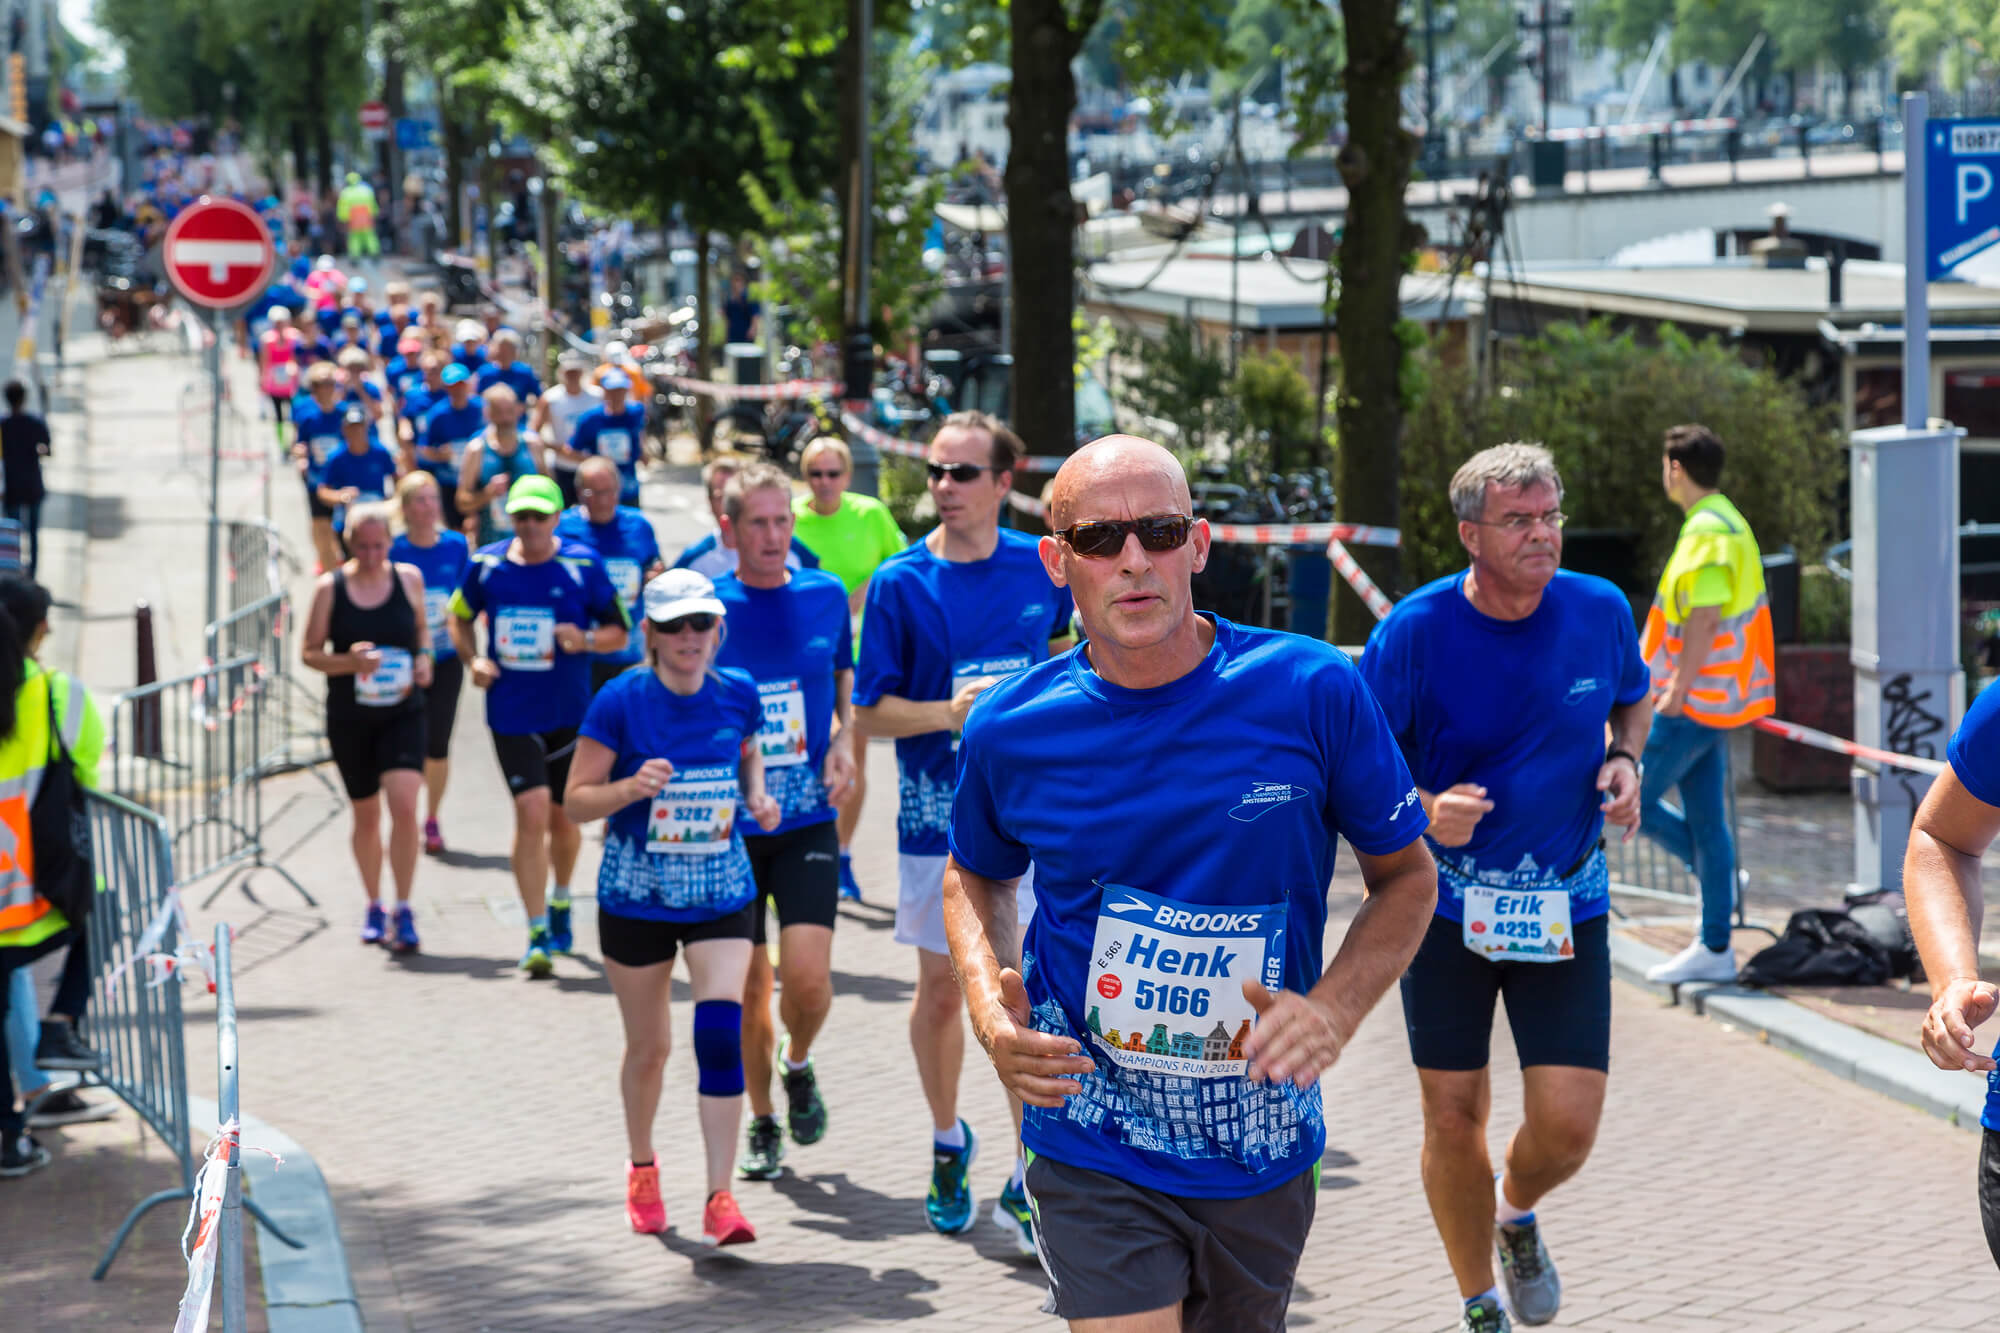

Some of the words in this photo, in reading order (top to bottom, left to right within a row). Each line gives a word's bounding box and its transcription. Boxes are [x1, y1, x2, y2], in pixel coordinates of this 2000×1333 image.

[1956, 164, 1994, 224] P
[1264, 784, 1292, 792] BROOKS
[674, 806, 713, 821] 5282
[1494, 895, 1545, 916] Erik
[1153, 905, 1263, 933] BROOKS
[1493, 921, 1543, 940] 4235
[1097, 958, 1108, 969] E
[1105, 940, 1122, 960] 563
[1125, 933, 1238, 978] Henk
[1134, 978, 1211, 1018] 5166
[1113, 1050, 1180, 1072] CHAMPIONS
[1181, 1061, 1208, 1075] RUN
[1209, 1062, 1240, 1074] 2016
